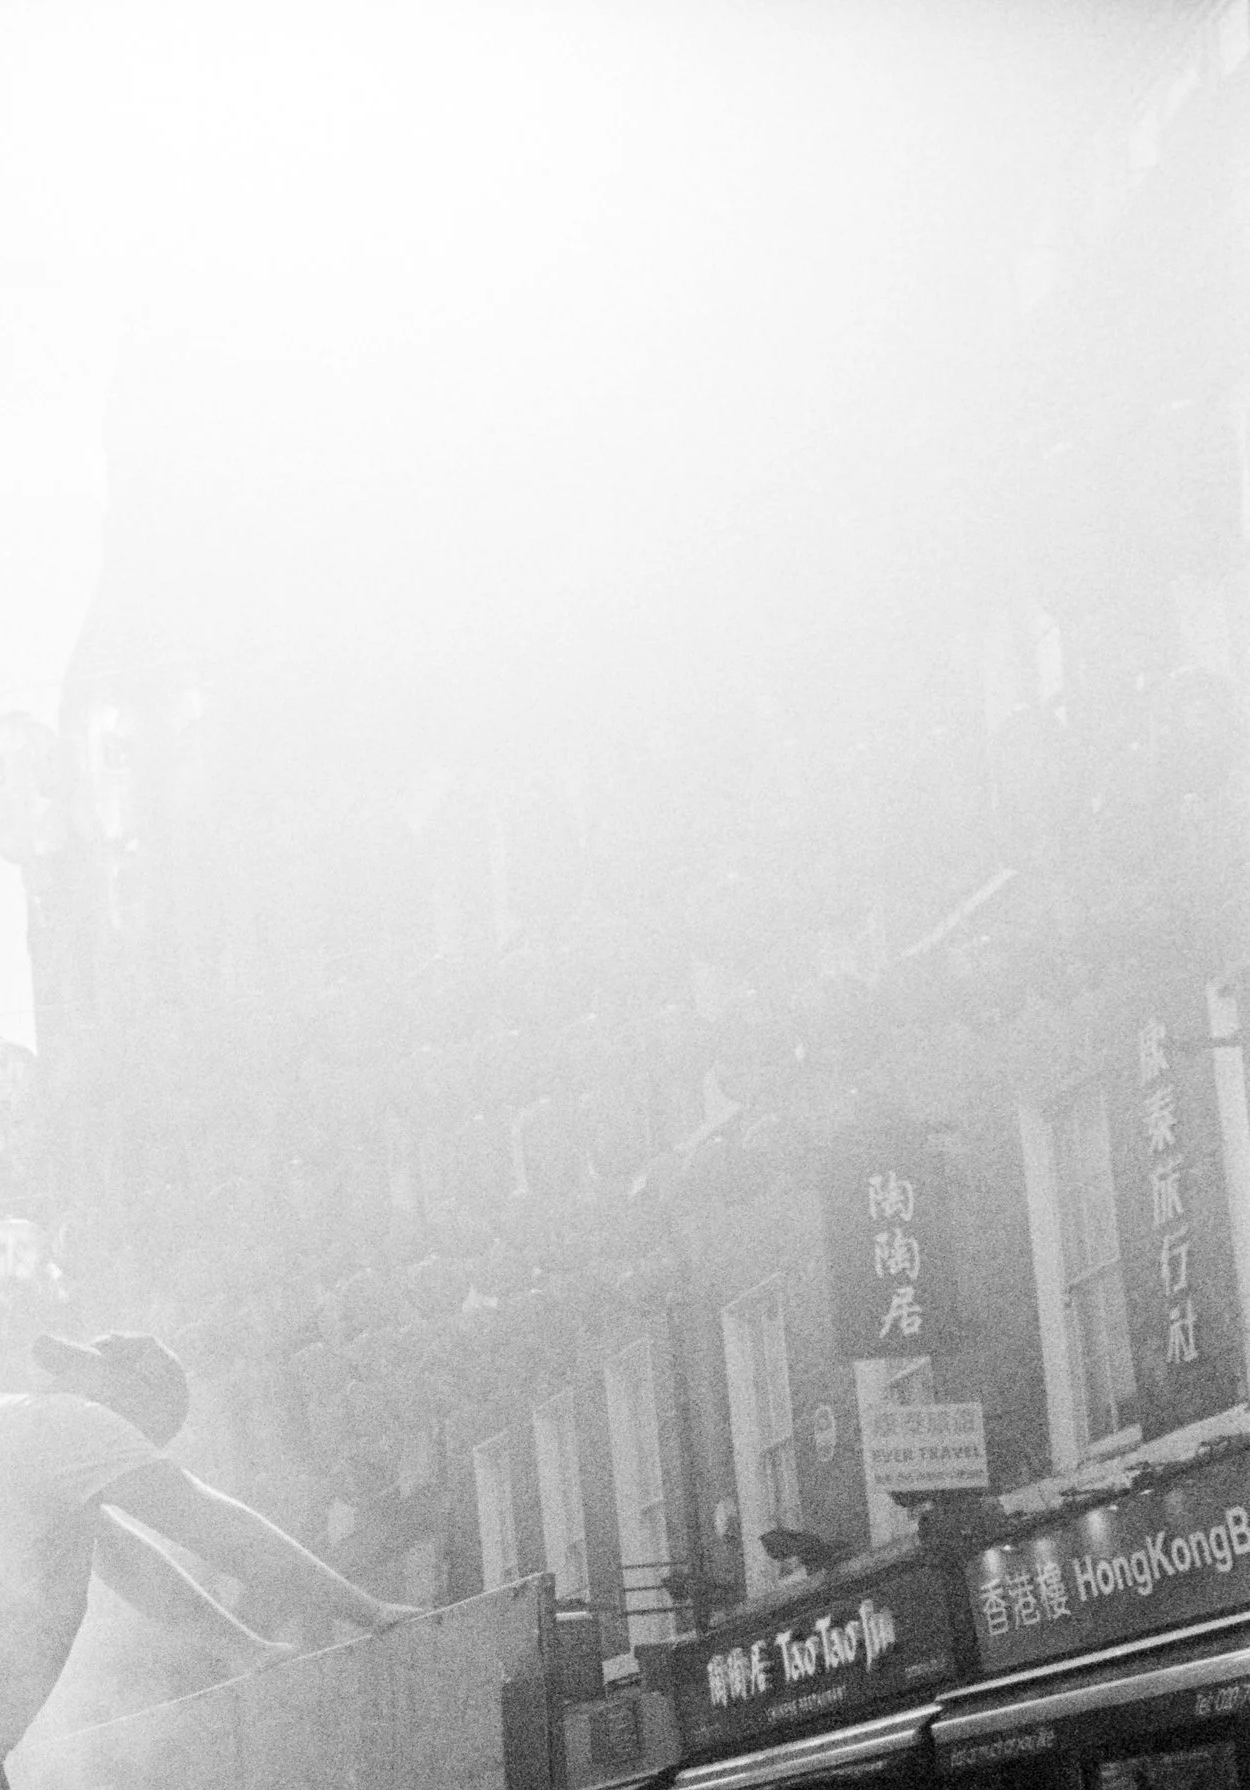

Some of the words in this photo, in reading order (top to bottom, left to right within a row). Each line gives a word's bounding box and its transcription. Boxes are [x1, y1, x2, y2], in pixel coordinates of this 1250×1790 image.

[867, 1170, 923, 1339] 陶陶居
[918, 1444, 982, 1460] TRAVEL
[980, 1560, 1071, 1636] 香港樓
